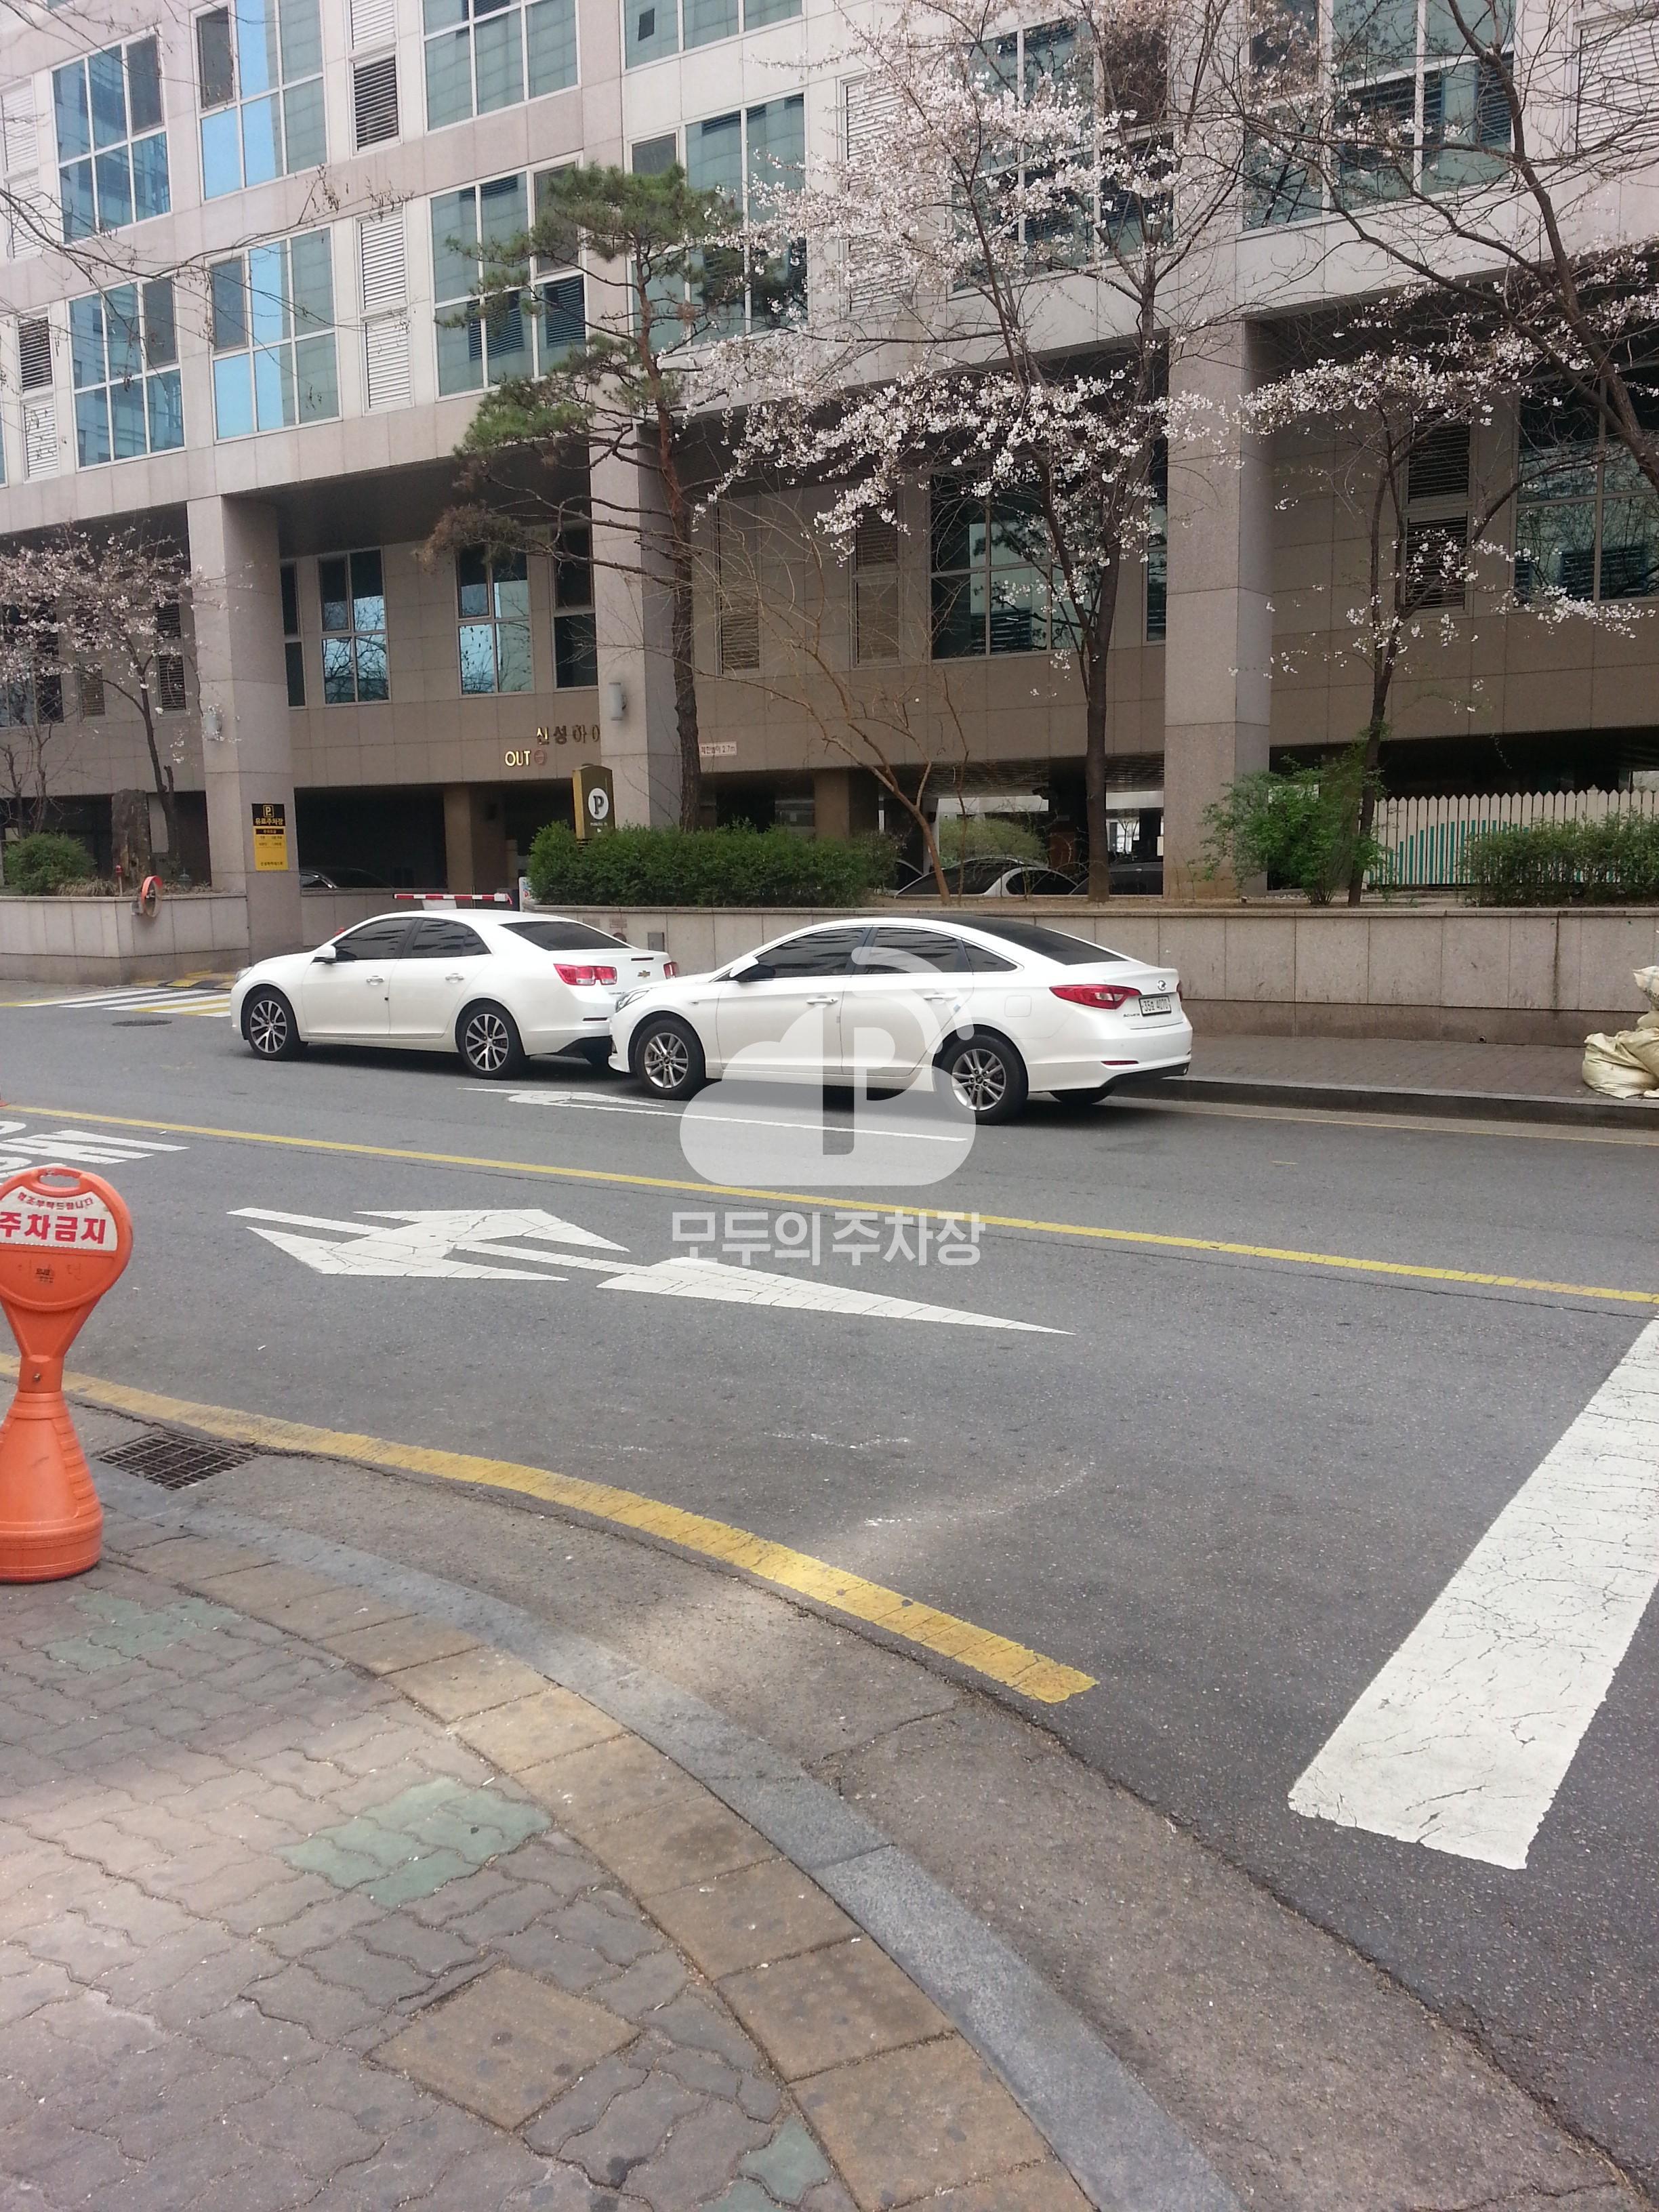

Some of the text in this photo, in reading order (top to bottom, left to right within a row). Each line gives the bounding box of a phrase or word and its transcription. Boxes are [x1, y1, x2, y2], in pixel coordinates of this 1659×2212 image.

[504, 750, 531, 766] OUT
[593, 796, 605, 815] P
[0, 1211, 106, 1244] 주차금지
